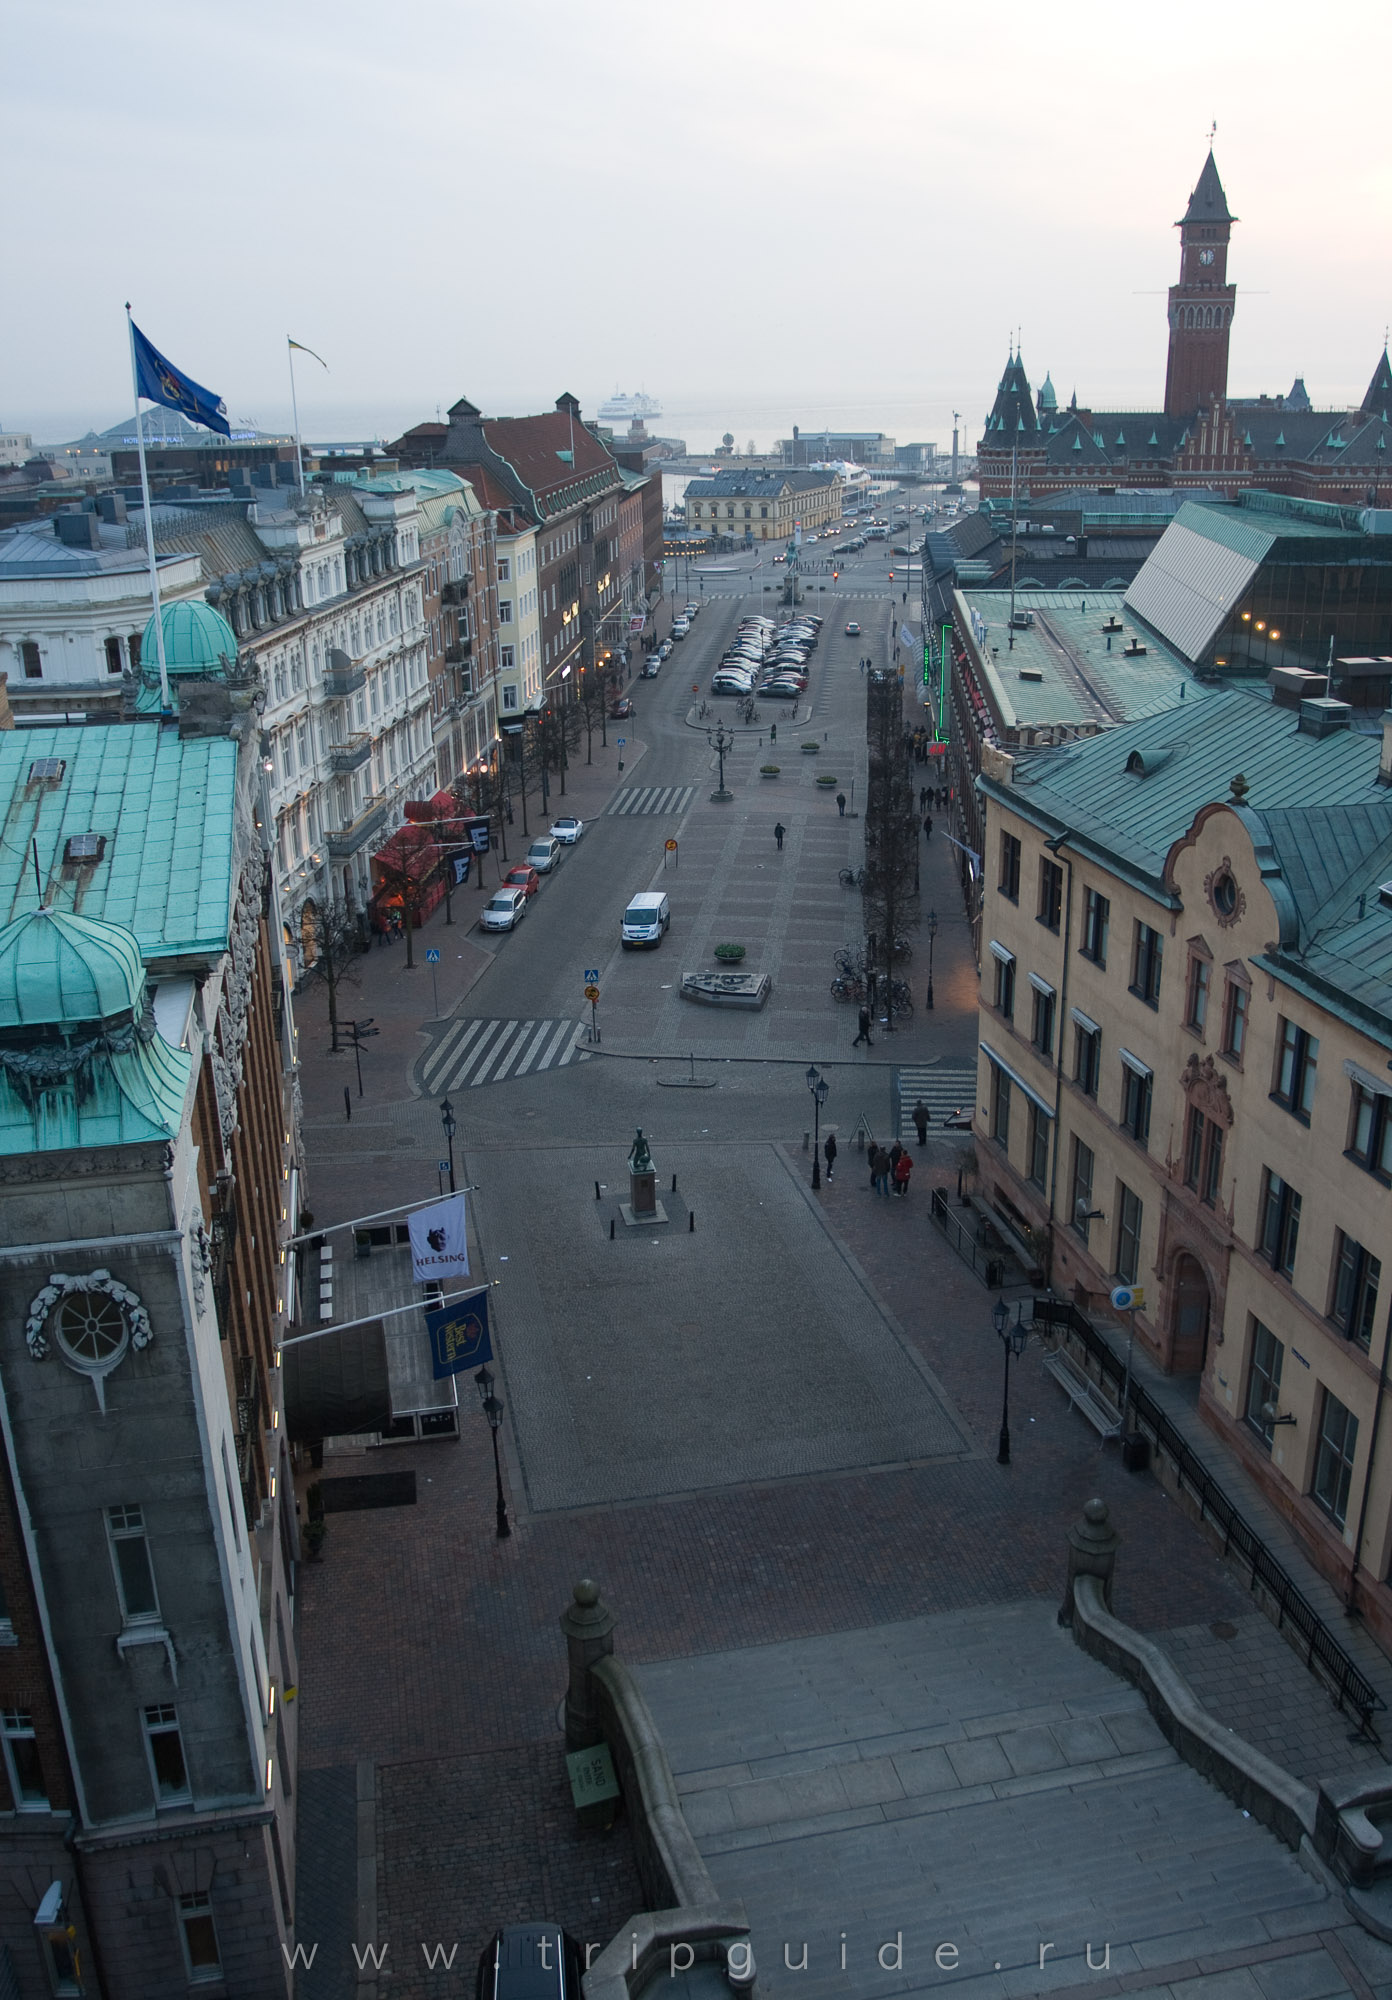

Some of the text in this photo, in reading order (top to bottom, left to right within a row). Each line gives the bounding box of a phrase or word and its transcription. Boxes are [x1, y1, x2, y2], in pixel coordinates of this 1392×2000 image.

[416, 1253, 465, 1266] HELSING
[445, 1322, 457, 1360] Western
[455, 1323, 467, 1346] Best
[591, 1759, 606, 1786] SAND
